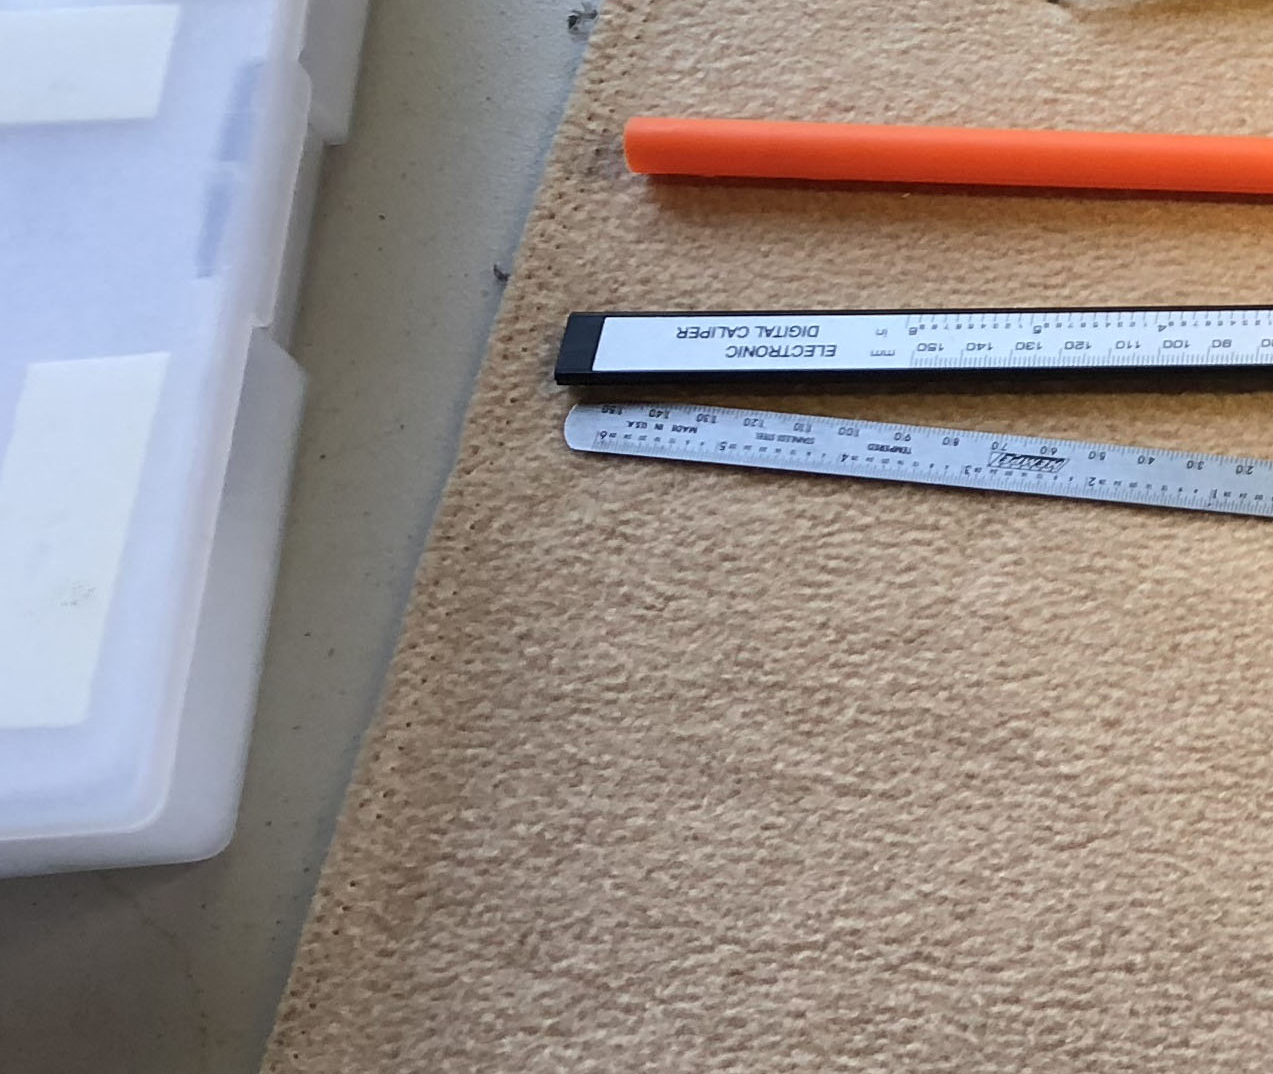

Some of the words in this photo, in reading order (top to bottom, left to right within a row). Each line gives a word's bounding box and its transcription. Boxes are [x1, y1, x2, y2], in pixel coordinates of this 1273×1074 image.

[676, 326, 750, 339] CALIPER
[754, 325, 820, 338] DIGITAL
[875, 328, 888, 338] in
[909, 327, 918, 336] 6
[1033, 325, 1043, 334] 5
[1157, 324, 1167, 332] 4
[917, 342, 945, 352] 150
[966, 342, 993, 351] 140
[1015, 341, 1042, 350] 130
[1064, 341, 1091, 350] 120
[1115, 340, 1141, 349] 110
[1162, 339, 1190, 348] 100
[725, 345, 838, 358] ELECTRONIC
[871, 349, 896, 357] mm
[649, 409, 671, 420] 140
[696, 414, 717, 424] 130
[654, 423, 664, 431] IN
[743, 417, 765, 428] 120
[599, 430, 608, 440] 6
[671, 425, 698, 435] MADE
[838, 427, 860, 437] 100
[893, 432, 911, 442] 90
[942, 436, 960, 446] 80
[719, 442, 729, 451] 5
[867, 443, 911, 455] TEMPERED
[991, 441, 1008, 451] 70
[1040, 446, 1058, 456] 60
[841, 453, 850, 463] 4
[1088, 450, 1107, 461] 50
[1137, 455, 1156, 466] 40
[964, 465, 972, 475] 3
[1186, 460, 1205, 471] 30
[1235, 464, 1254, 475] 20
[1088, 476, 1096, 487] 2
